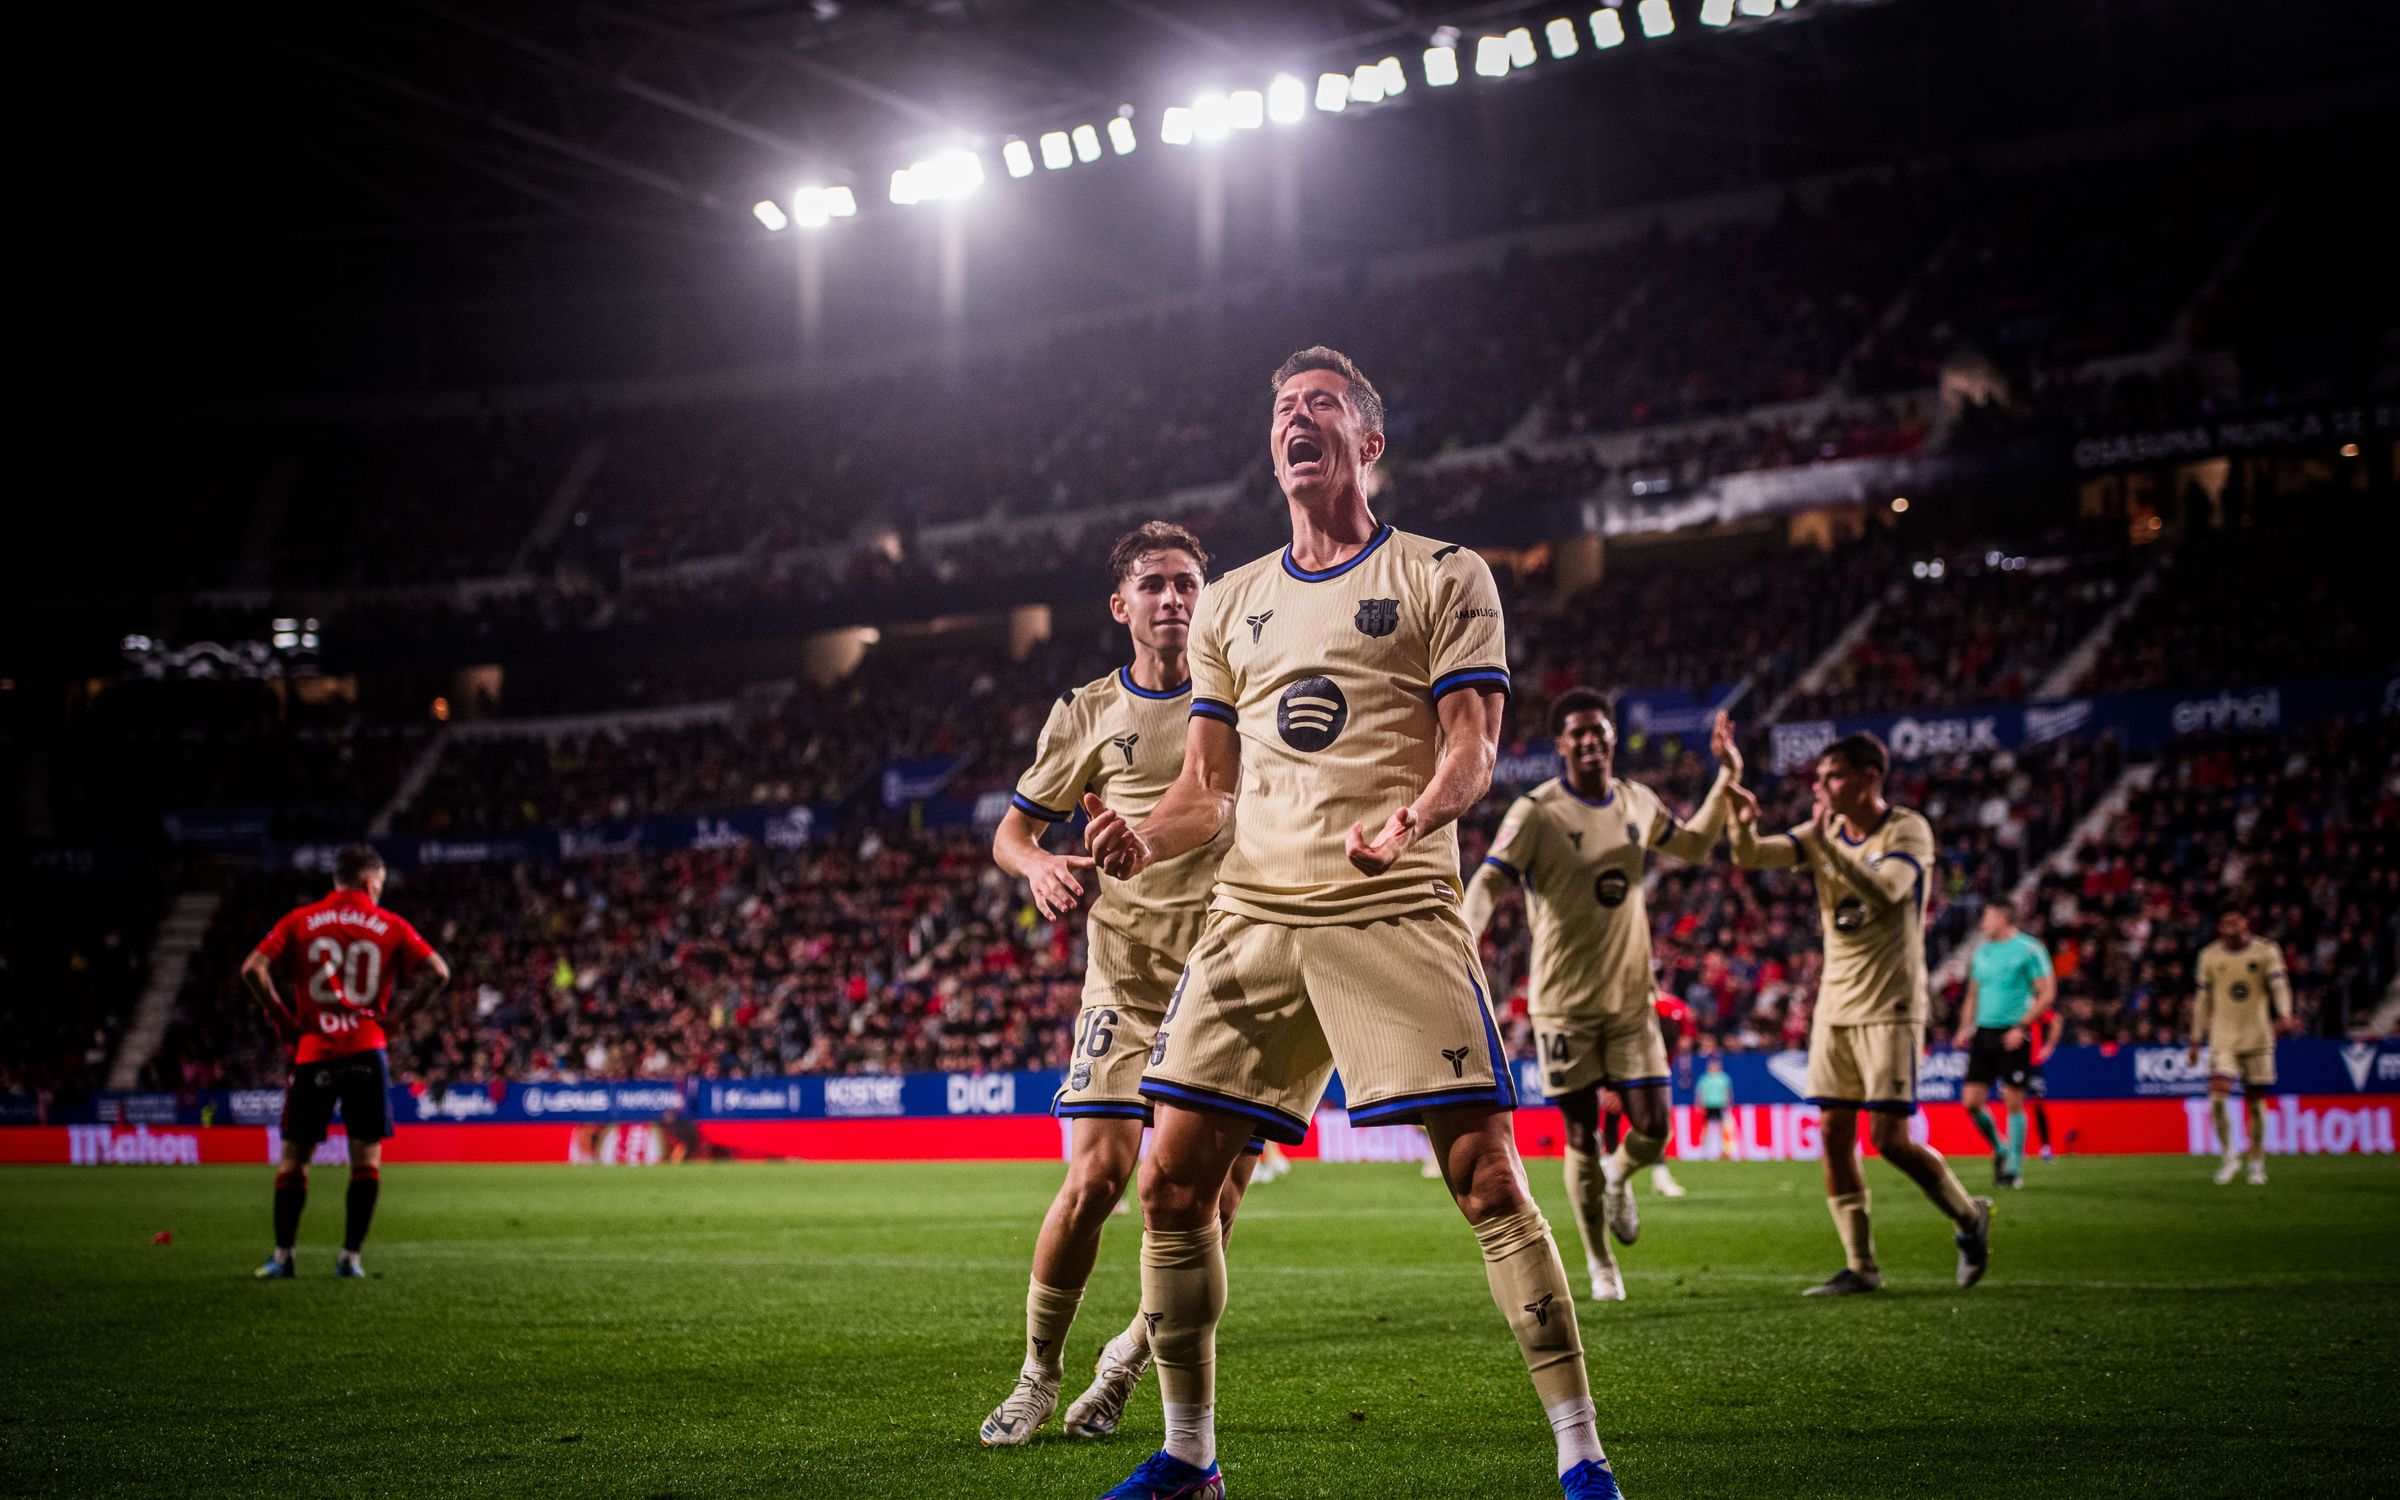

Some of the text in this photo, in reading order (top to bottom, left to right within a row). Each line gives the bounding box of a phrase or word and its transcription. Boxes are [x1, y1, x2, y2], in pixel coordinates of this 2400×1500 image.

[1454, 607, 1502, 620] AMBILIGH
[308, 936, 382, 1006] 20
[1076, 1009, 1118, 1058] 16
[1541, 1033, 1570, 1065] 14
[947, 1073, 1016, 1114] DIGI
[1674, 1105, 1863, 1161] LLIG
